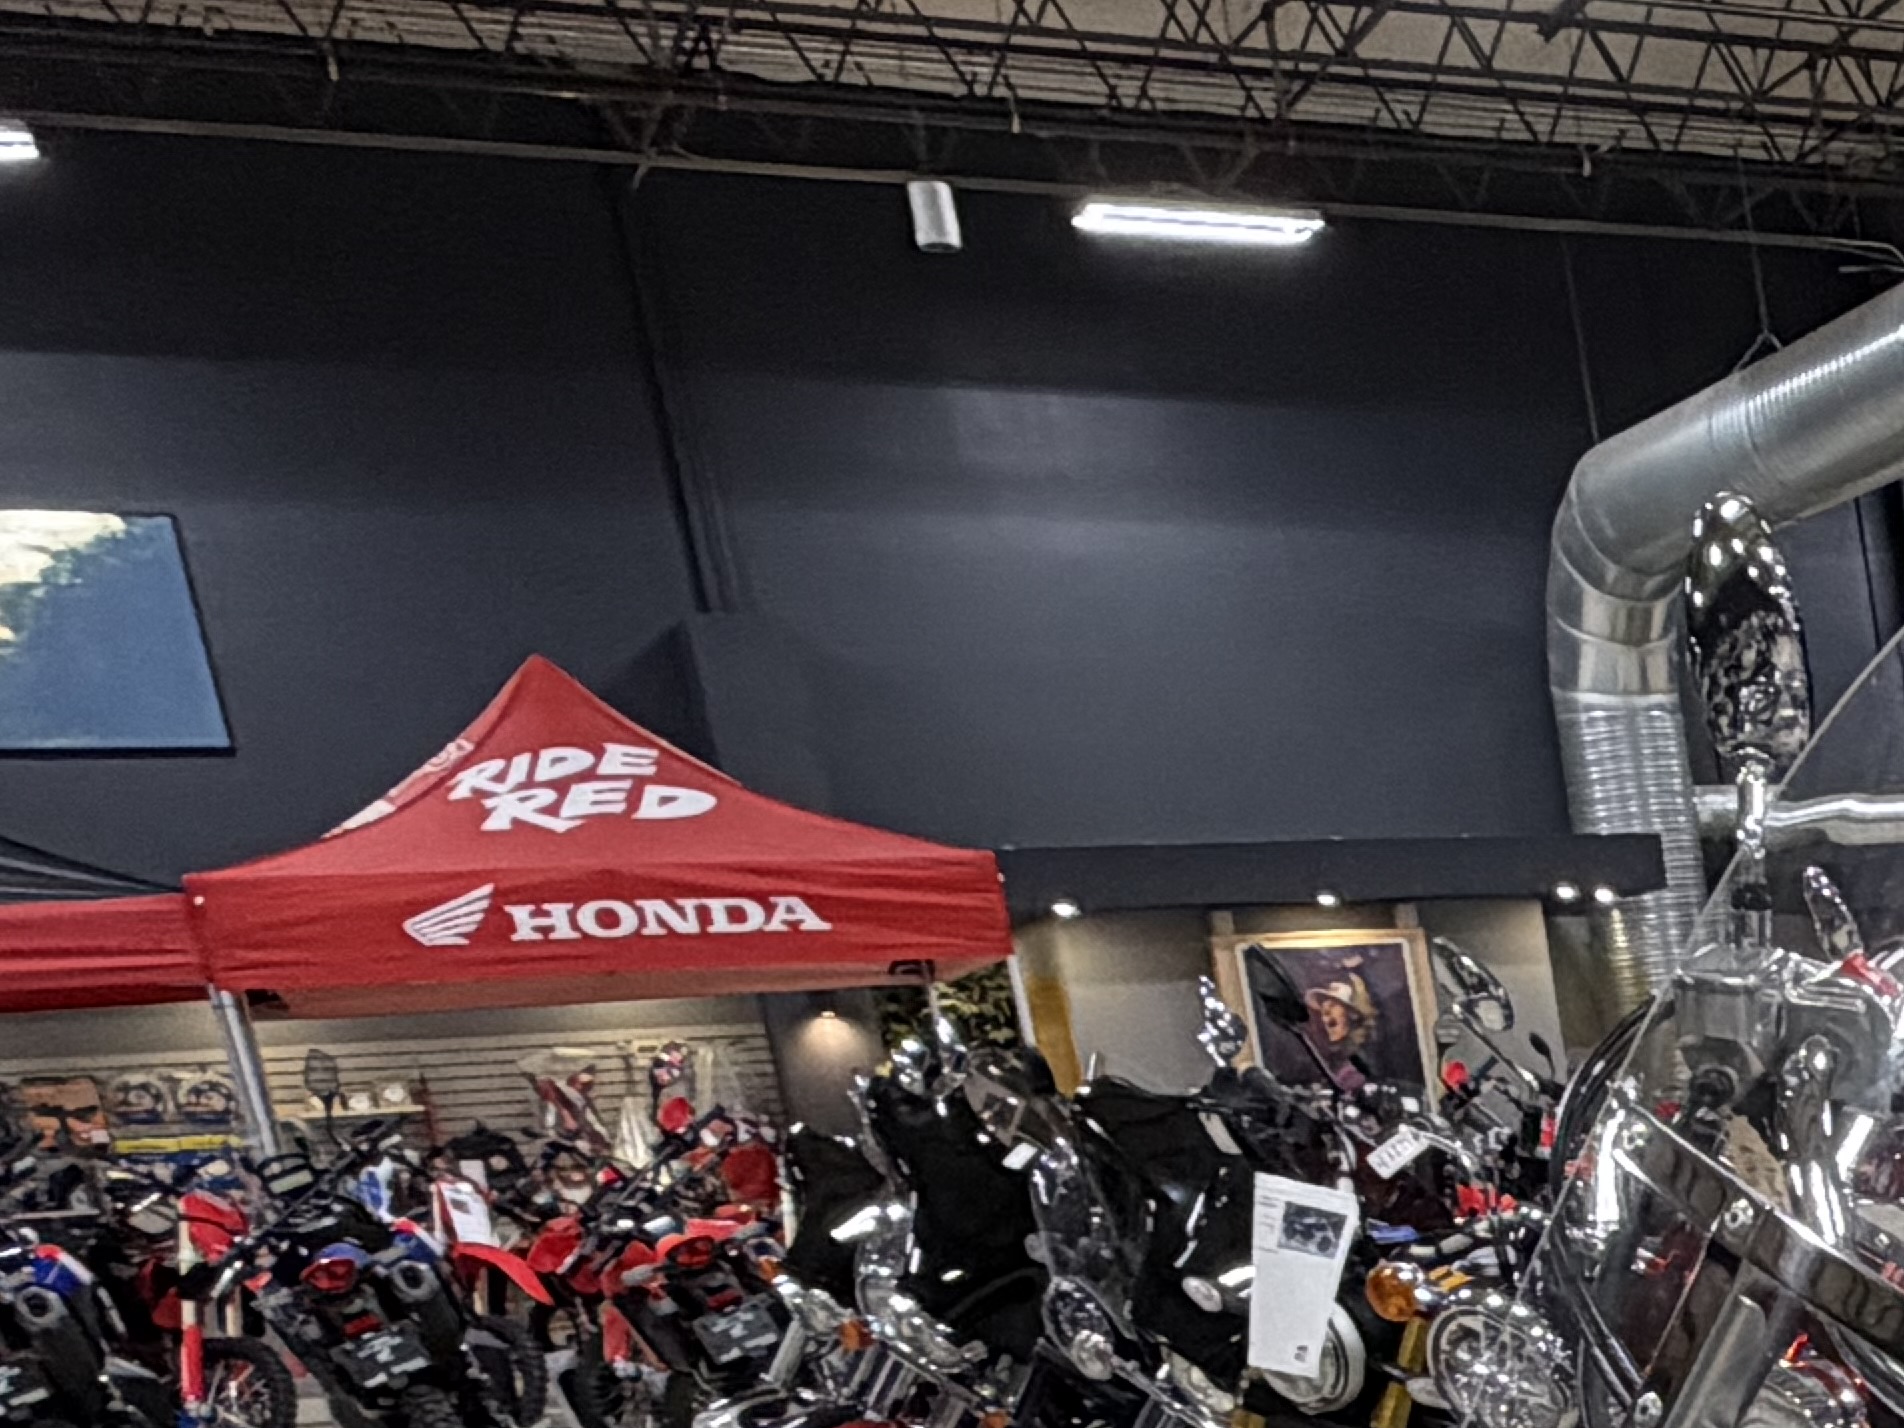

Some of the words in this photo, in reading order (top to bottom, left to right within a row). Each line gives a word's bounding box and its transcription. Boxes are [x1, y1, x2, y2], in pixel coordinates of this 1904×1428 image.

[448, 743, 658, 801] RIDE
[481, 779, 717, 833] RED
[503, 896, 832, 941] HONDA
